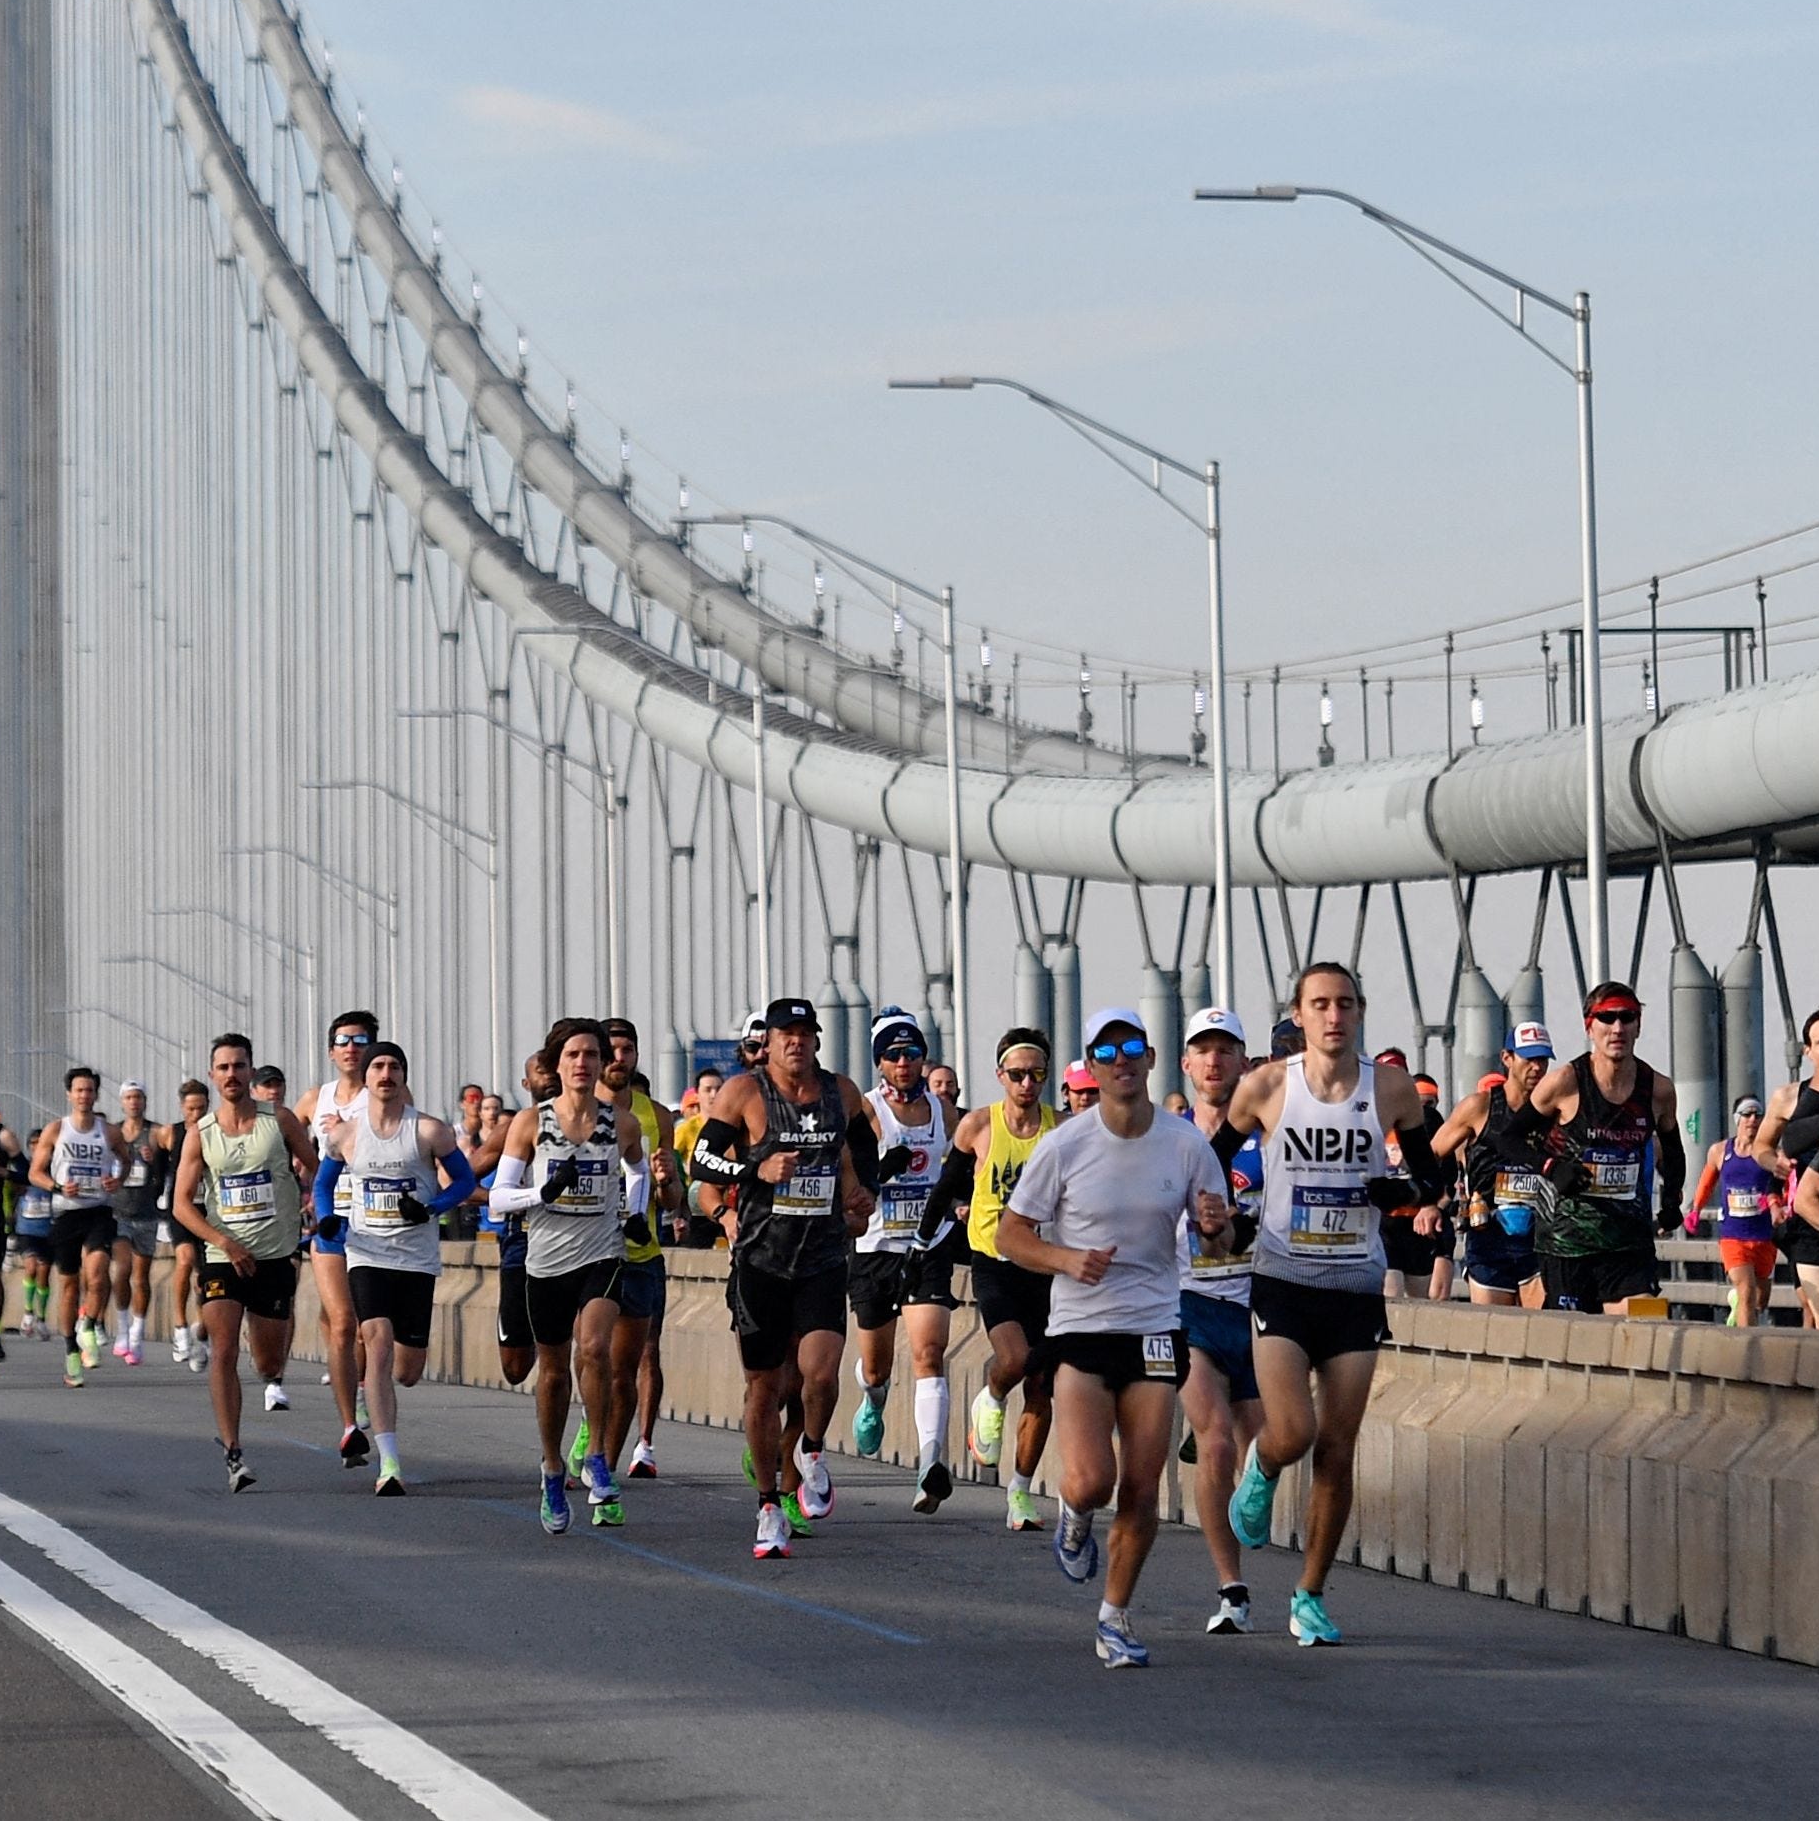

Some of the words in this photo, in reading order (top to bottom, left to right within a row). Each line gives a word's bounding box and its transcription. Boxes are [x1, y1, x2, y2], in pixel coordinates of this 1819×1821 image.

[779, 1131, 837, 1143] SAYSKY
[1586, 1127, 1647, 1141] HUNGARY
[62, 1142, 103, 1161] NBR
[1284, 1127, 1373, 1164] NBR
[1604, 1166, 1627, 1185] 1336
[239, 1187, 258, 1203] 460
[799, 1178, 821, 1197] 456
[1302, 1189, 1323, 1204] tcs
[1322, 1209, 1348, 1232] 472
[1146, 1337, 1174, 1360] 475
